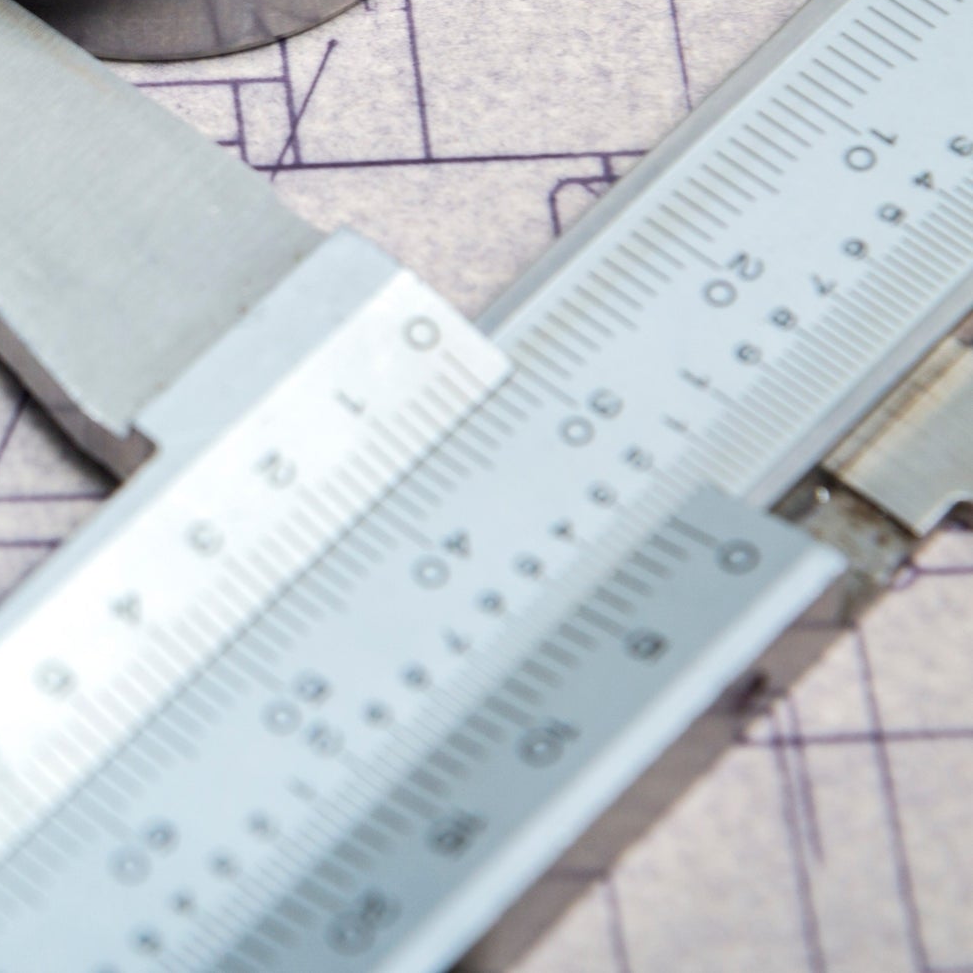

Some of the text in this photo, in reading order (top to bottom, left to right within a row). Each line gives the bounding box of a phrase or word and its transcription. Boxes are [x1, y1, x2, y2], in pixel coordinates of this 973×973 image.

[844, 127, 898, 172] 10
[947, 135, 973, 157] 3
[915, 172, 934, 189] 4
[879, 205, 905, 224] 5
[844, 239, 867, 258] 6
[704, 252, 764, 307] 20
[812, 275, 837, 296] 7
[772, 307, 796, 329] 8
[403, 314, 441, 352] 0
[736, 342, 760, 364] 9
[680, 370, 709, 391] 1
[337, 391, 366, 414] 1
[559, 388, 623, 447] 30
[665, 415, 689, 432] 1
[256, 448, 296, 487] 2
[625, 446, 653, 470] 2
[590, 483, 616, 506] 3
[187, 518, 225, 558] 3
[410, 526, 471, 591] 40
[715, 538, 762, 576] 0
[111, 591, 143, 625] 4
[260, 668, 332, 737] 50
[515, 717, 579, 769] 10
